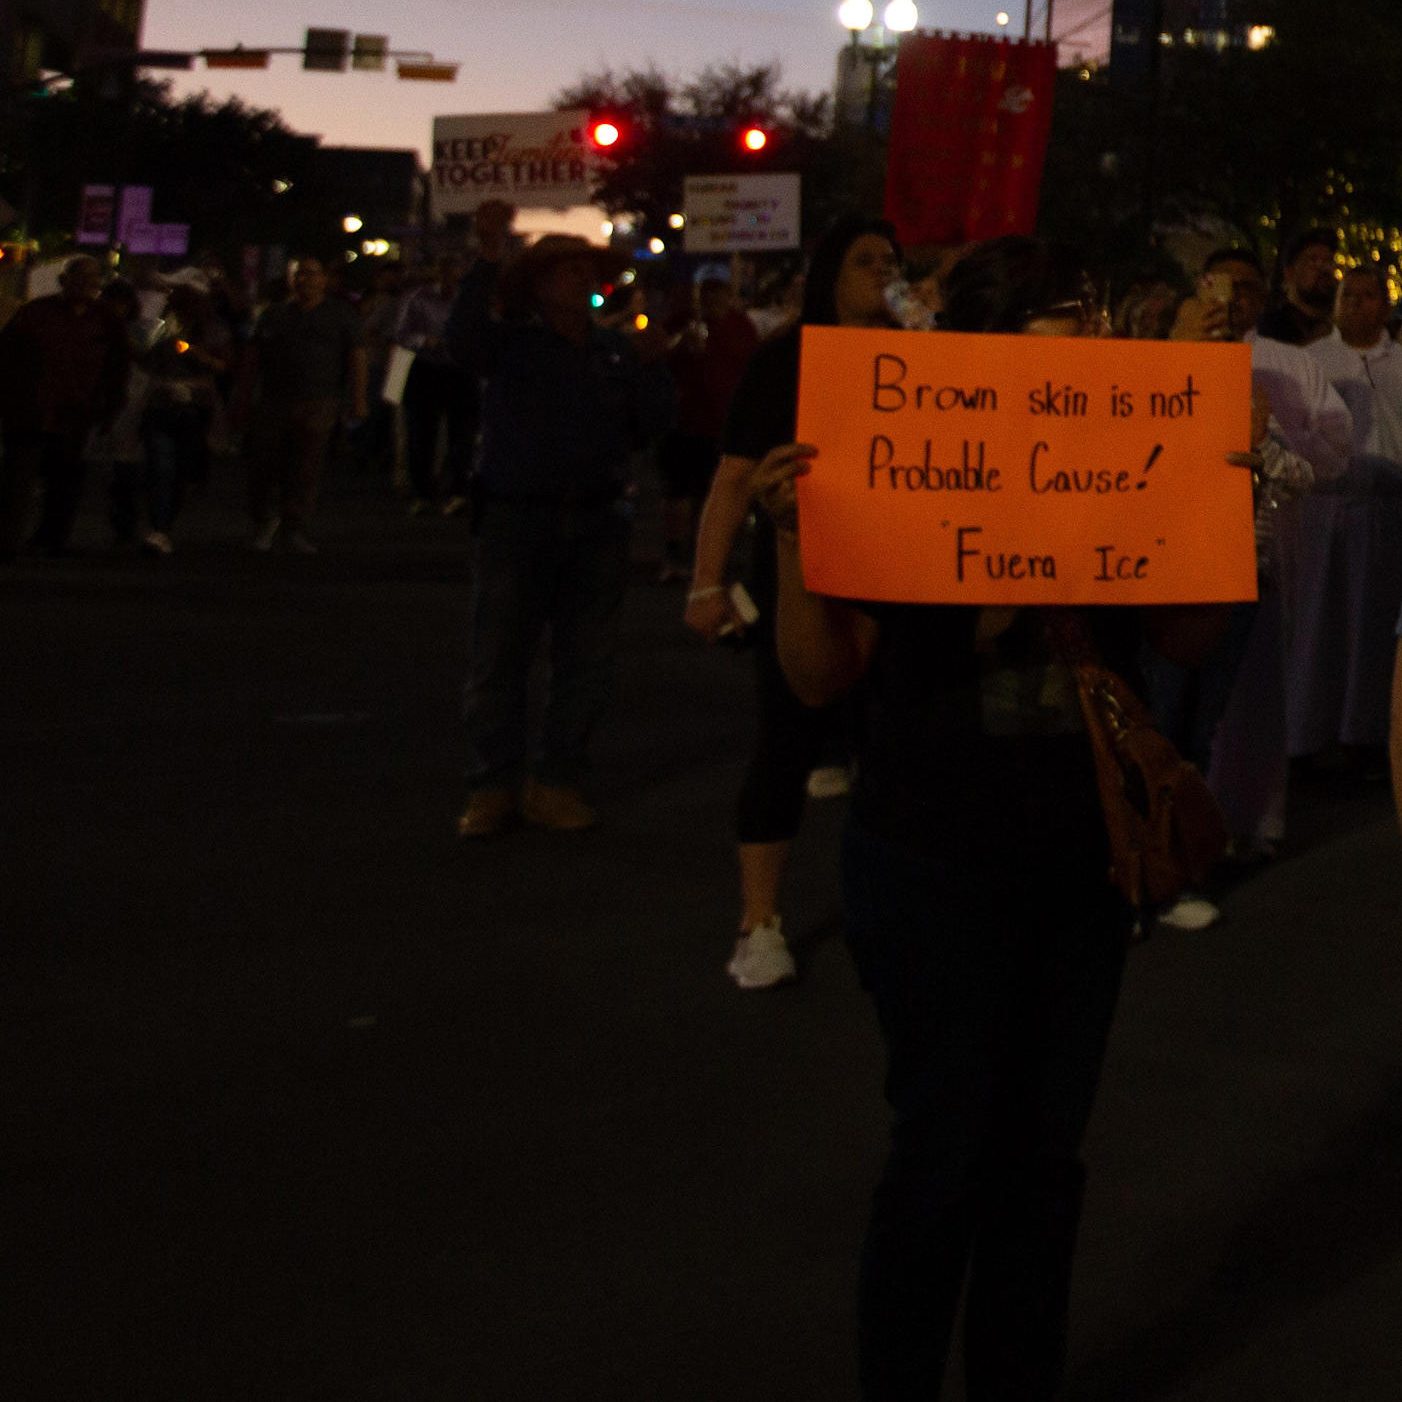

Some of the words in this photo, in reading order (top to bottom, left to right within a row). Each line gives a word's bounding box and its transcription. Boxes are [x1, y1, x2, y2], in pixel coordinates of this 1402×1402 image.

[434, 137, 498, 161] KEEP
[433, 159, 585, 188] TOGETHER
[872, 353, 998, 413] Brown
[1028, 380, 1088, 418] skin
[1110, 384, 1134, 418] is
[1150, 374, 1201, 419] not
[868, 435, 1002, 493] Probable
[1028, 440, 1165, 494] Cause!
